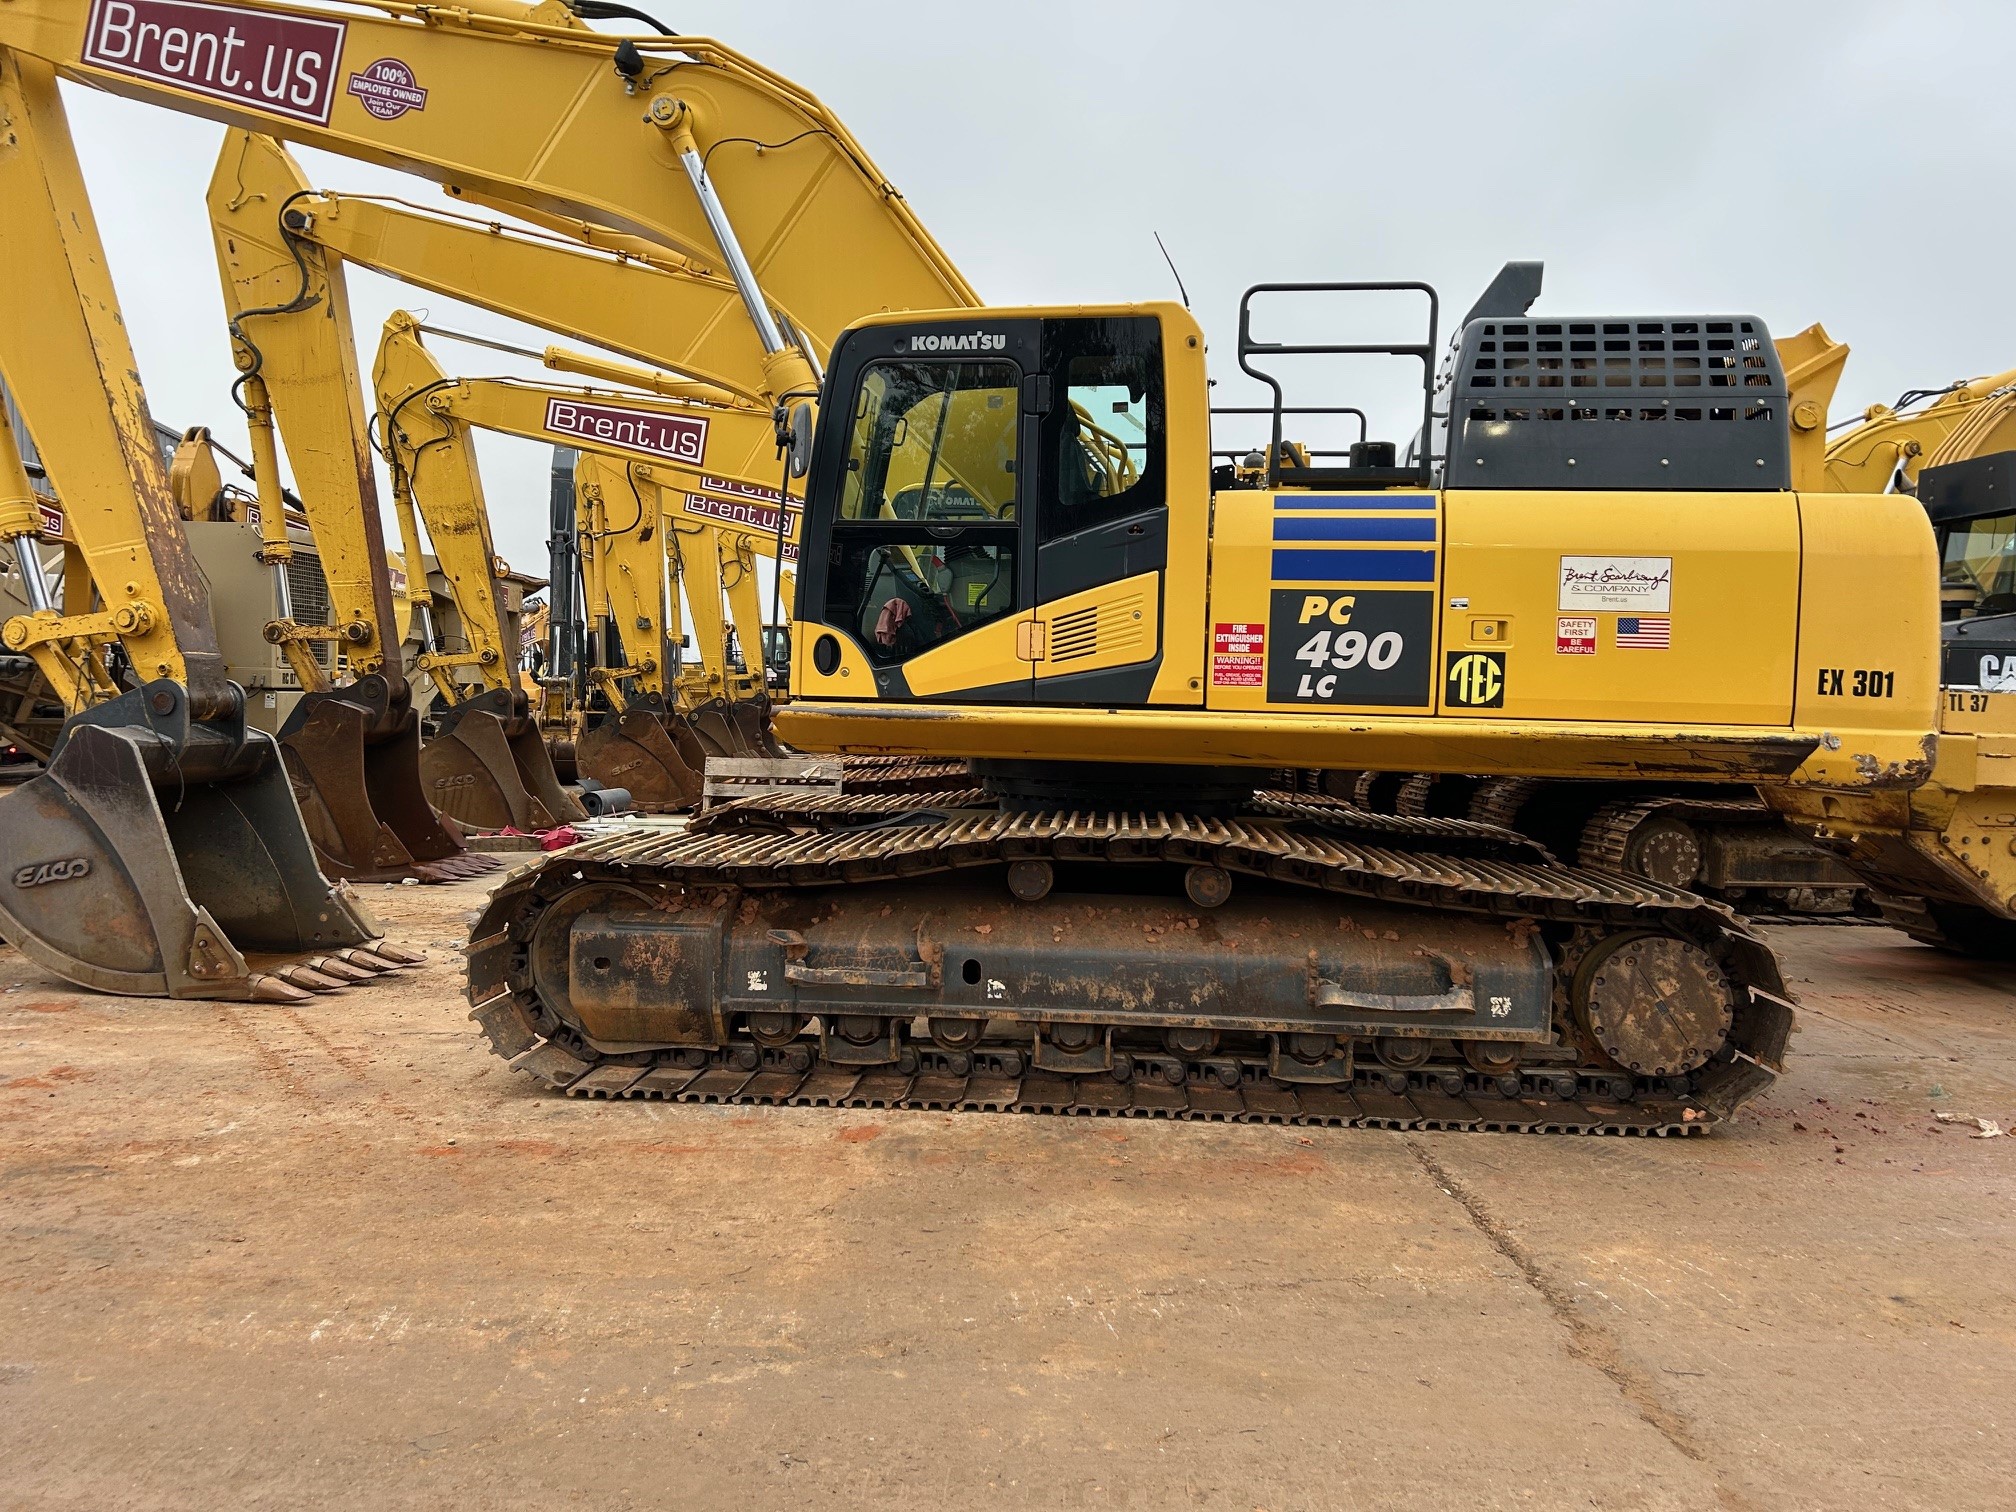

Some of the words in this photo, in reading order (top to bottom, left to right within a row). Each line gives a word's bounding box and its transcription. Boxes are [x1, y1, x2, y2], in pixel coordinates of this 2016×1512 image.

[98, 1, 323, 107] Brent.us
[376, 65, 407, 85] 100%
[352, 79, 392, 96] EMPLOYEE
[392, 88, 422, 103] OWNED
[367, 97, 384, 107] Join
[385, 101, 402, 110] Our
[372, 105, 393, 116] TEAM
[911, 330, 1006, 351] KOMATSU
[553, 404, 698, 457] Brent.us
[1563, 566, 1599, 587] Brent
[1584, 584, 1650, 593] COMPANY
[1298, 595, 1356, 626] PC
[1232, 625, 1248, 633] FIRE
[1560, 620, 1594, 628] SAFETY
[1216, 634, 1263, 643] EXTINGUISHER
[1228, 644, 1250, 652] INSIDE
[1570, 638, 1582, 646] BE
[1295, 630, 1404, 671] 490
[1557, 646, 1595, 654] CAREFUL
[1296, 674, 1338, 698] LC
[1817, 668, 1845, 696] EX
[1852, 669, 1894, 698] 301
[1949, 694, 1965, 711] TL
[1970, 695, 1989, 712] 37
